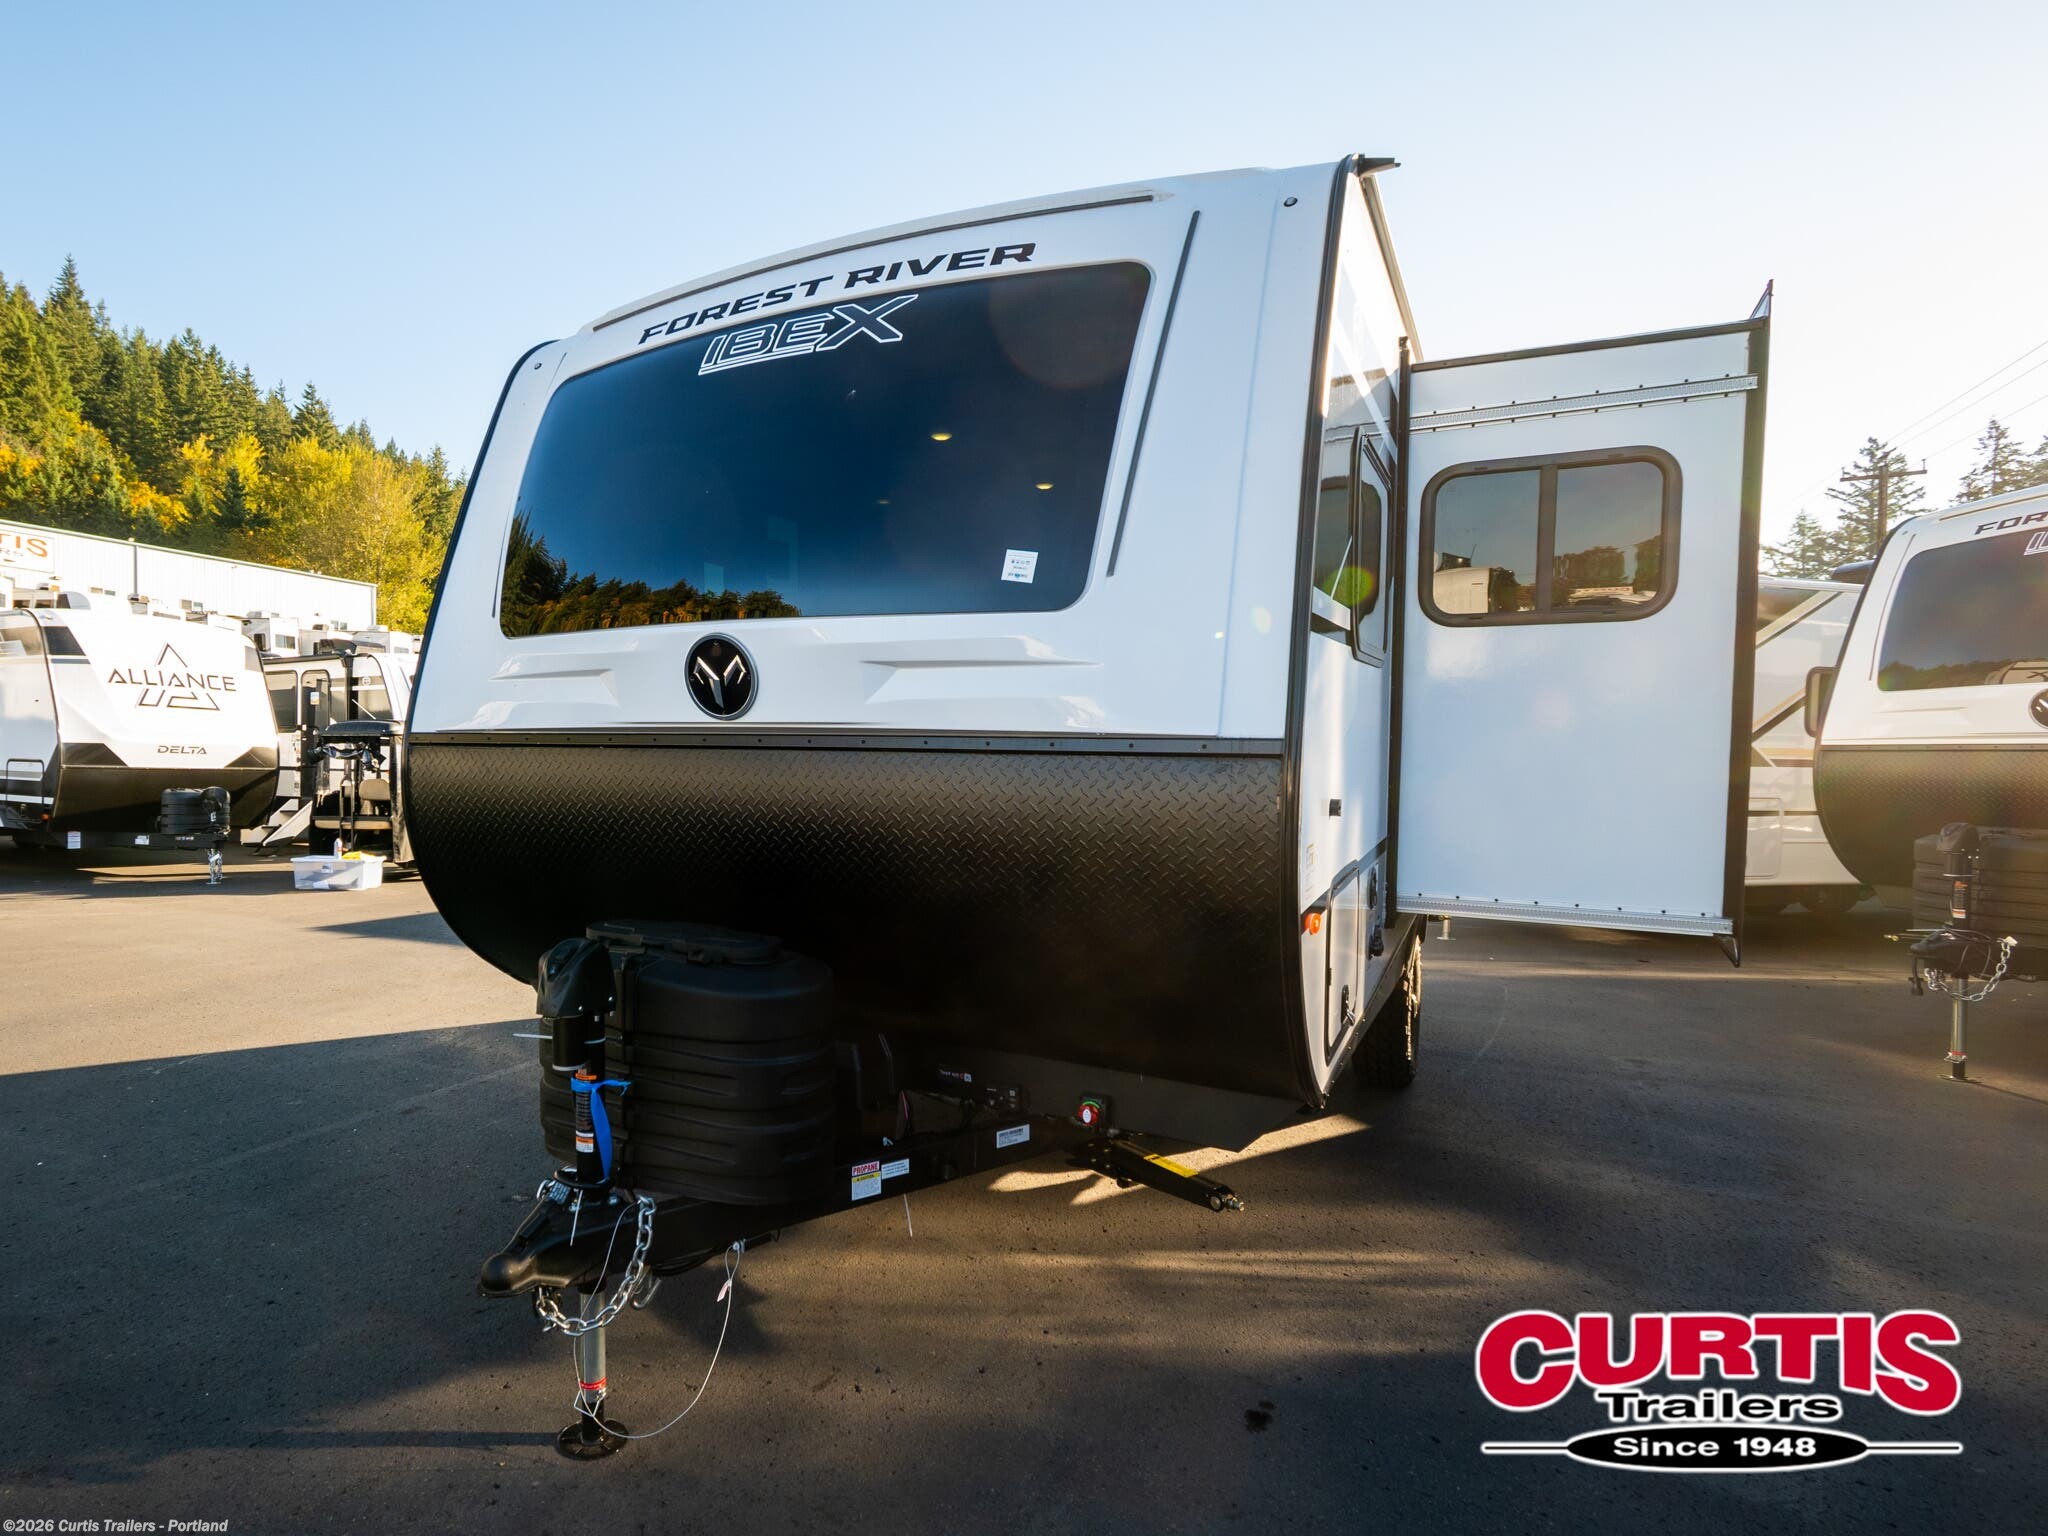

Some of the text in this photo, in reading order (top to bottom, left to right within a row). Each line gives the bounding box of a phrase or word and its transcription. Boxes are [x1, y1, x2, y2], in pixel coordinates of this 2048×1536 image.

[638, 242, 1037, 345] FOREST RIVER
[698, 293, 919, 376] IBEX
[107, 667, 237, 692] ALLIANCE
[157, 745, 207, 755] DELTA
[852, 1162, 879, 1176] PROPANE
